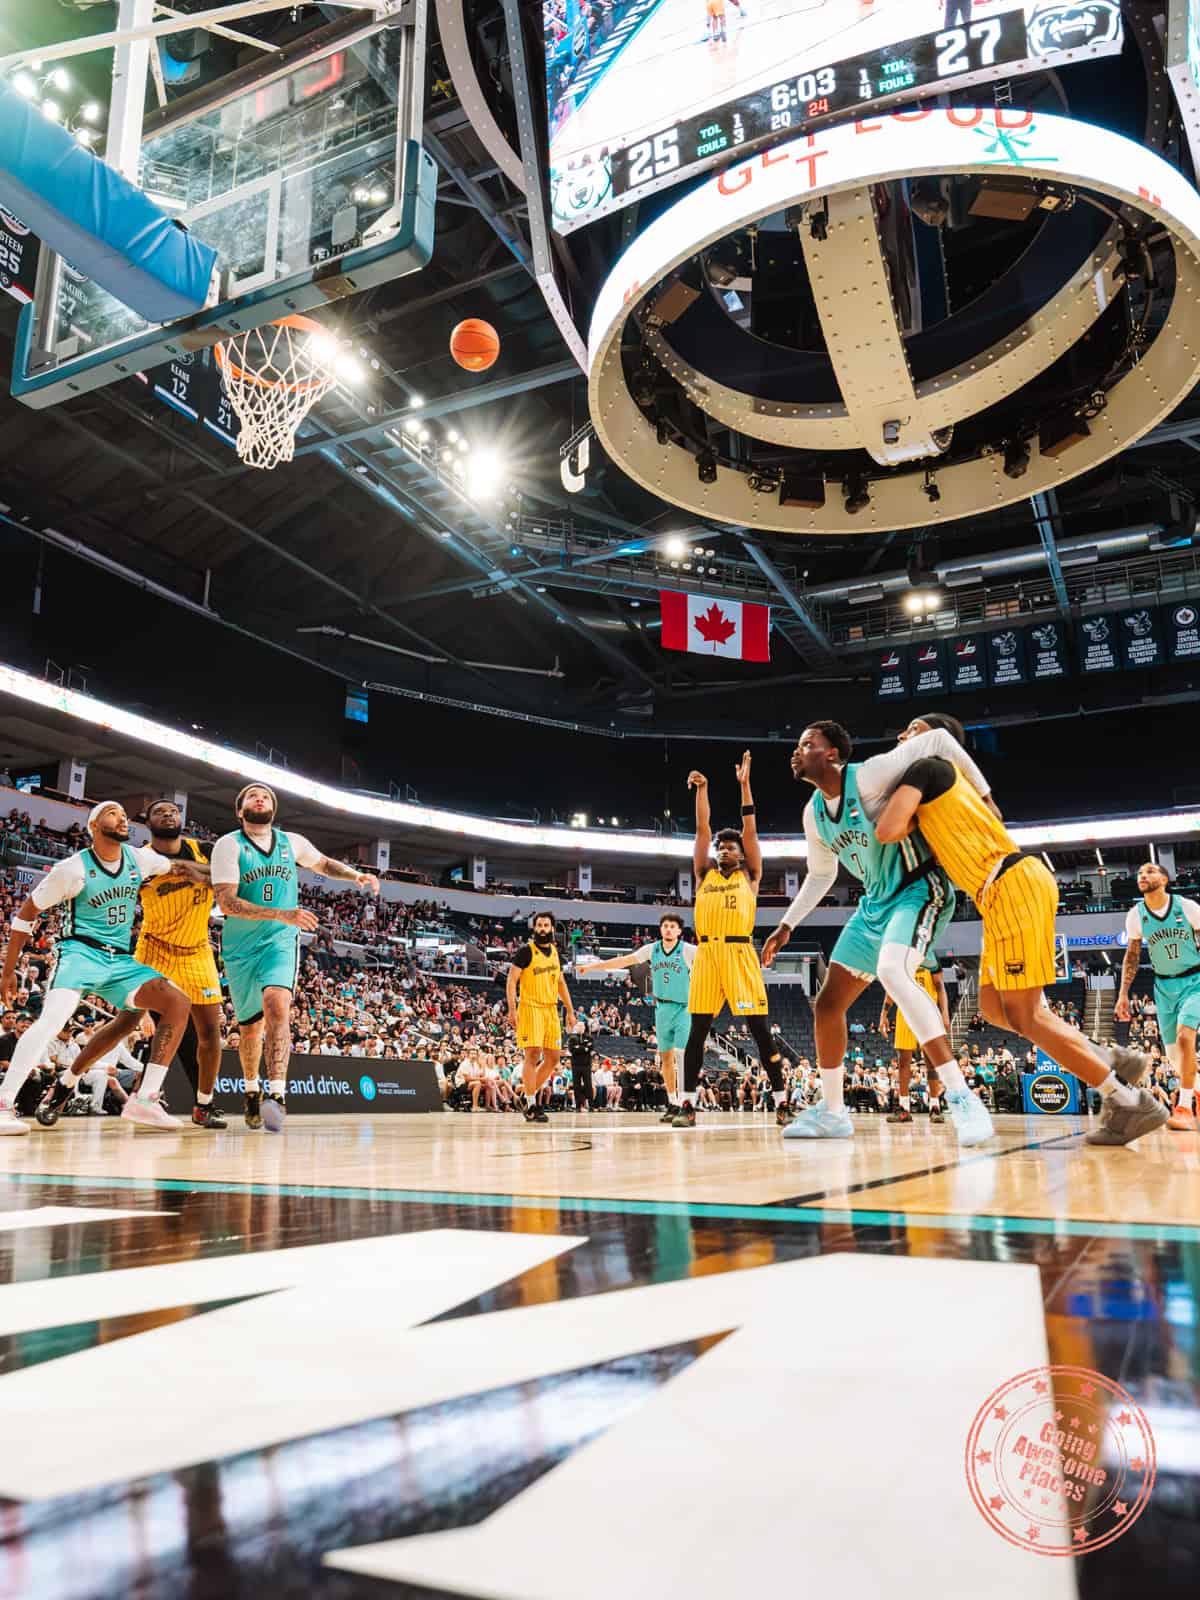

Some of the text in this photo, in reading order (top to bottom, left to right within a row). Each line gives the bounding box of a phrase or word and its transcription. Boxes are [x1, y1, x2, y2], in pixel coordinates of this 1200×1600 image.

[935, 18, 1001, 77] 27
[859, 59, 907, 84] 1 TOL
[771, 67, 836, 111] 6:03
[859, 73, 914, 99] 4 FOULS
[808, 98, 829, 117] 24
[700, 112, 742, 139] TOL 1
[771, 111, 791, 131] 20
[697, 127, 744, 157] FOULS 3
[628, 127, 680, 187] 25
[0, 230, 23, 254] STEEN
[0, 245, 21, 275] 25
[171, 377, 187, 401] 12
[217, 405, 232, 430] 21
[850, 852, 865, 875] 7
[18, 871, 33, 882] 119
[88, 885, 138, 909] WINNIPE
[262, 882, 273, 902] 8
[724, 895, 737, 910] 12
[107, 904, 127, 926] 55
[1165, 943, 1180, 960] 17
[663, 972, 670, 984] 5
[214, 1076, 246, 1094] Neve
[290, 1075, 314, 1095] and
[317, 1076, 353, 1096] drive.
